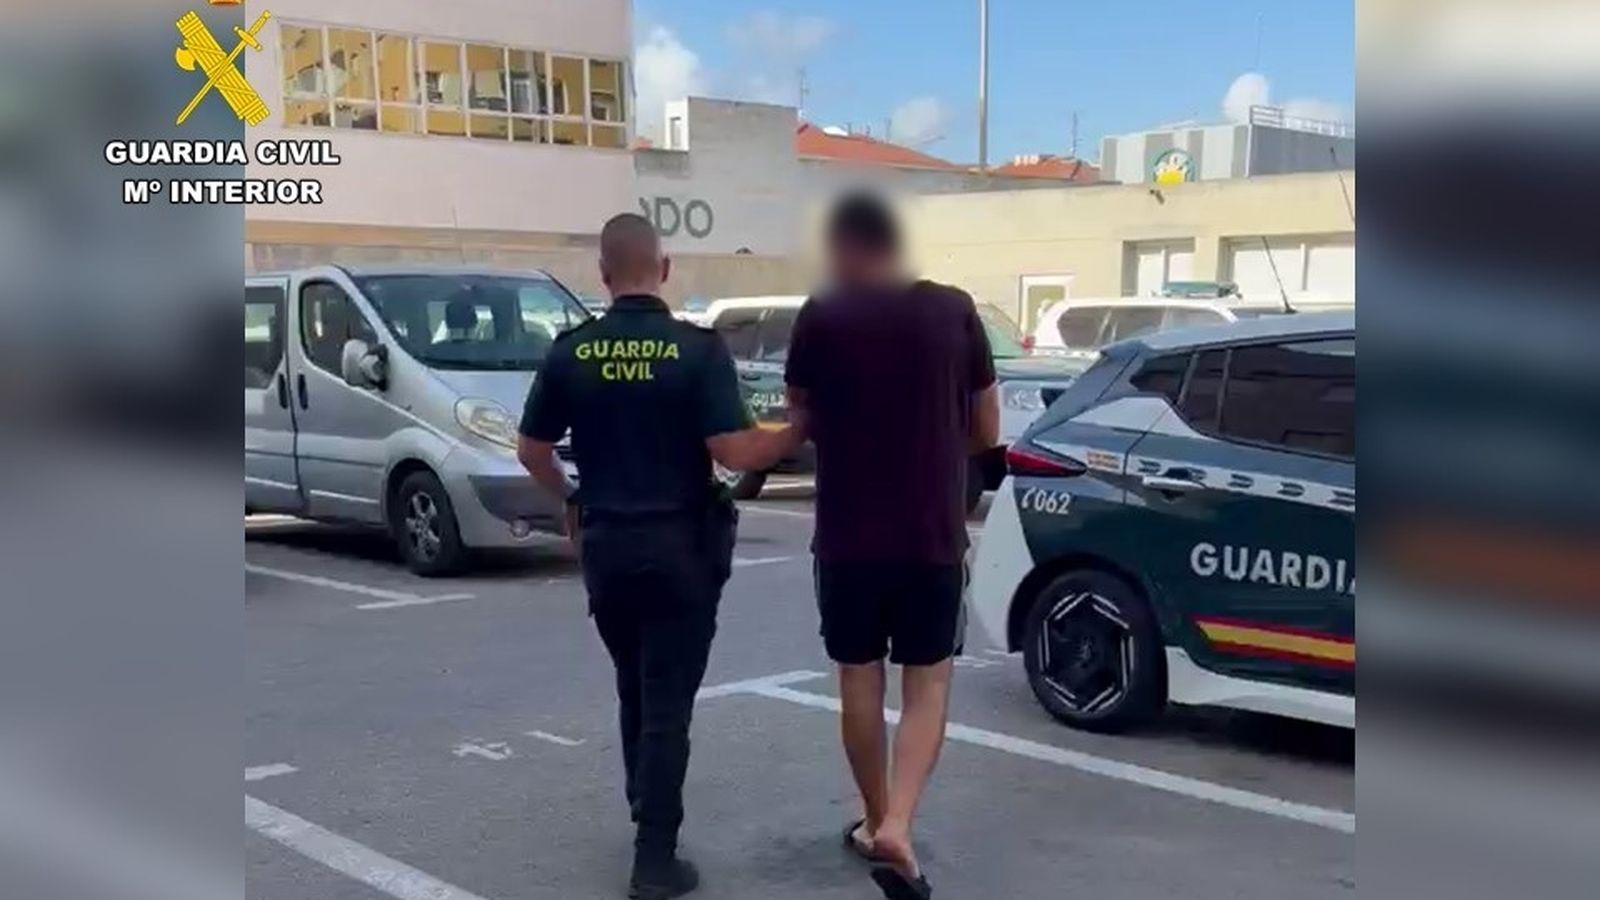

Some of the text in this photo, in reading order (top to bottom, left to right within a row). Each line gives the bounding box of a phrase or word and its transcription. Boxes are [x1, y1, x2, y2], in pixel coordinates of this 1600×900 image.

[575, 341, 680, 362] GUARDIA
[601, 362, 655, 382] CIVIL
[1033, 490, 1071, 515] 062
[1191, 543, 1355, 595] GUARDI
